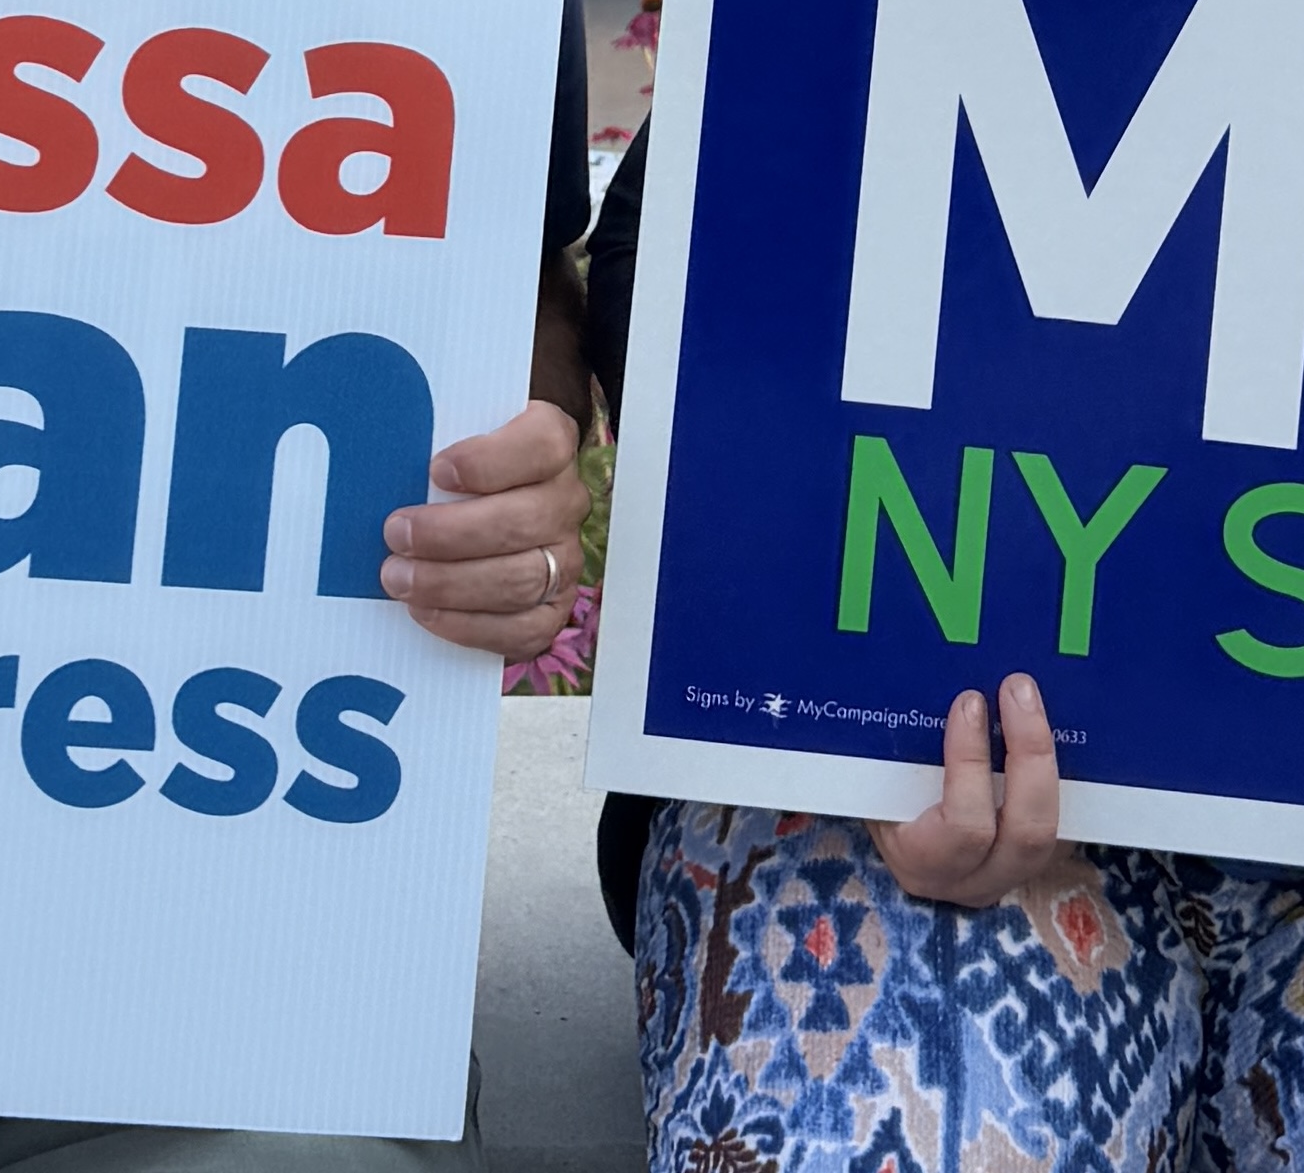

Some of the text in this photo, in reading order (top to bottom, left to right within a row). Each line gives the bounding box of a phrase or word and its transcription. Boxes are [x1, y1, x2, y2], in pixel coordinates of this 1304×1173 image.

[838, 436, 1165, 661] NY
[686, 686, 729, 709] Signs
[735, 689, 755, 712] by
